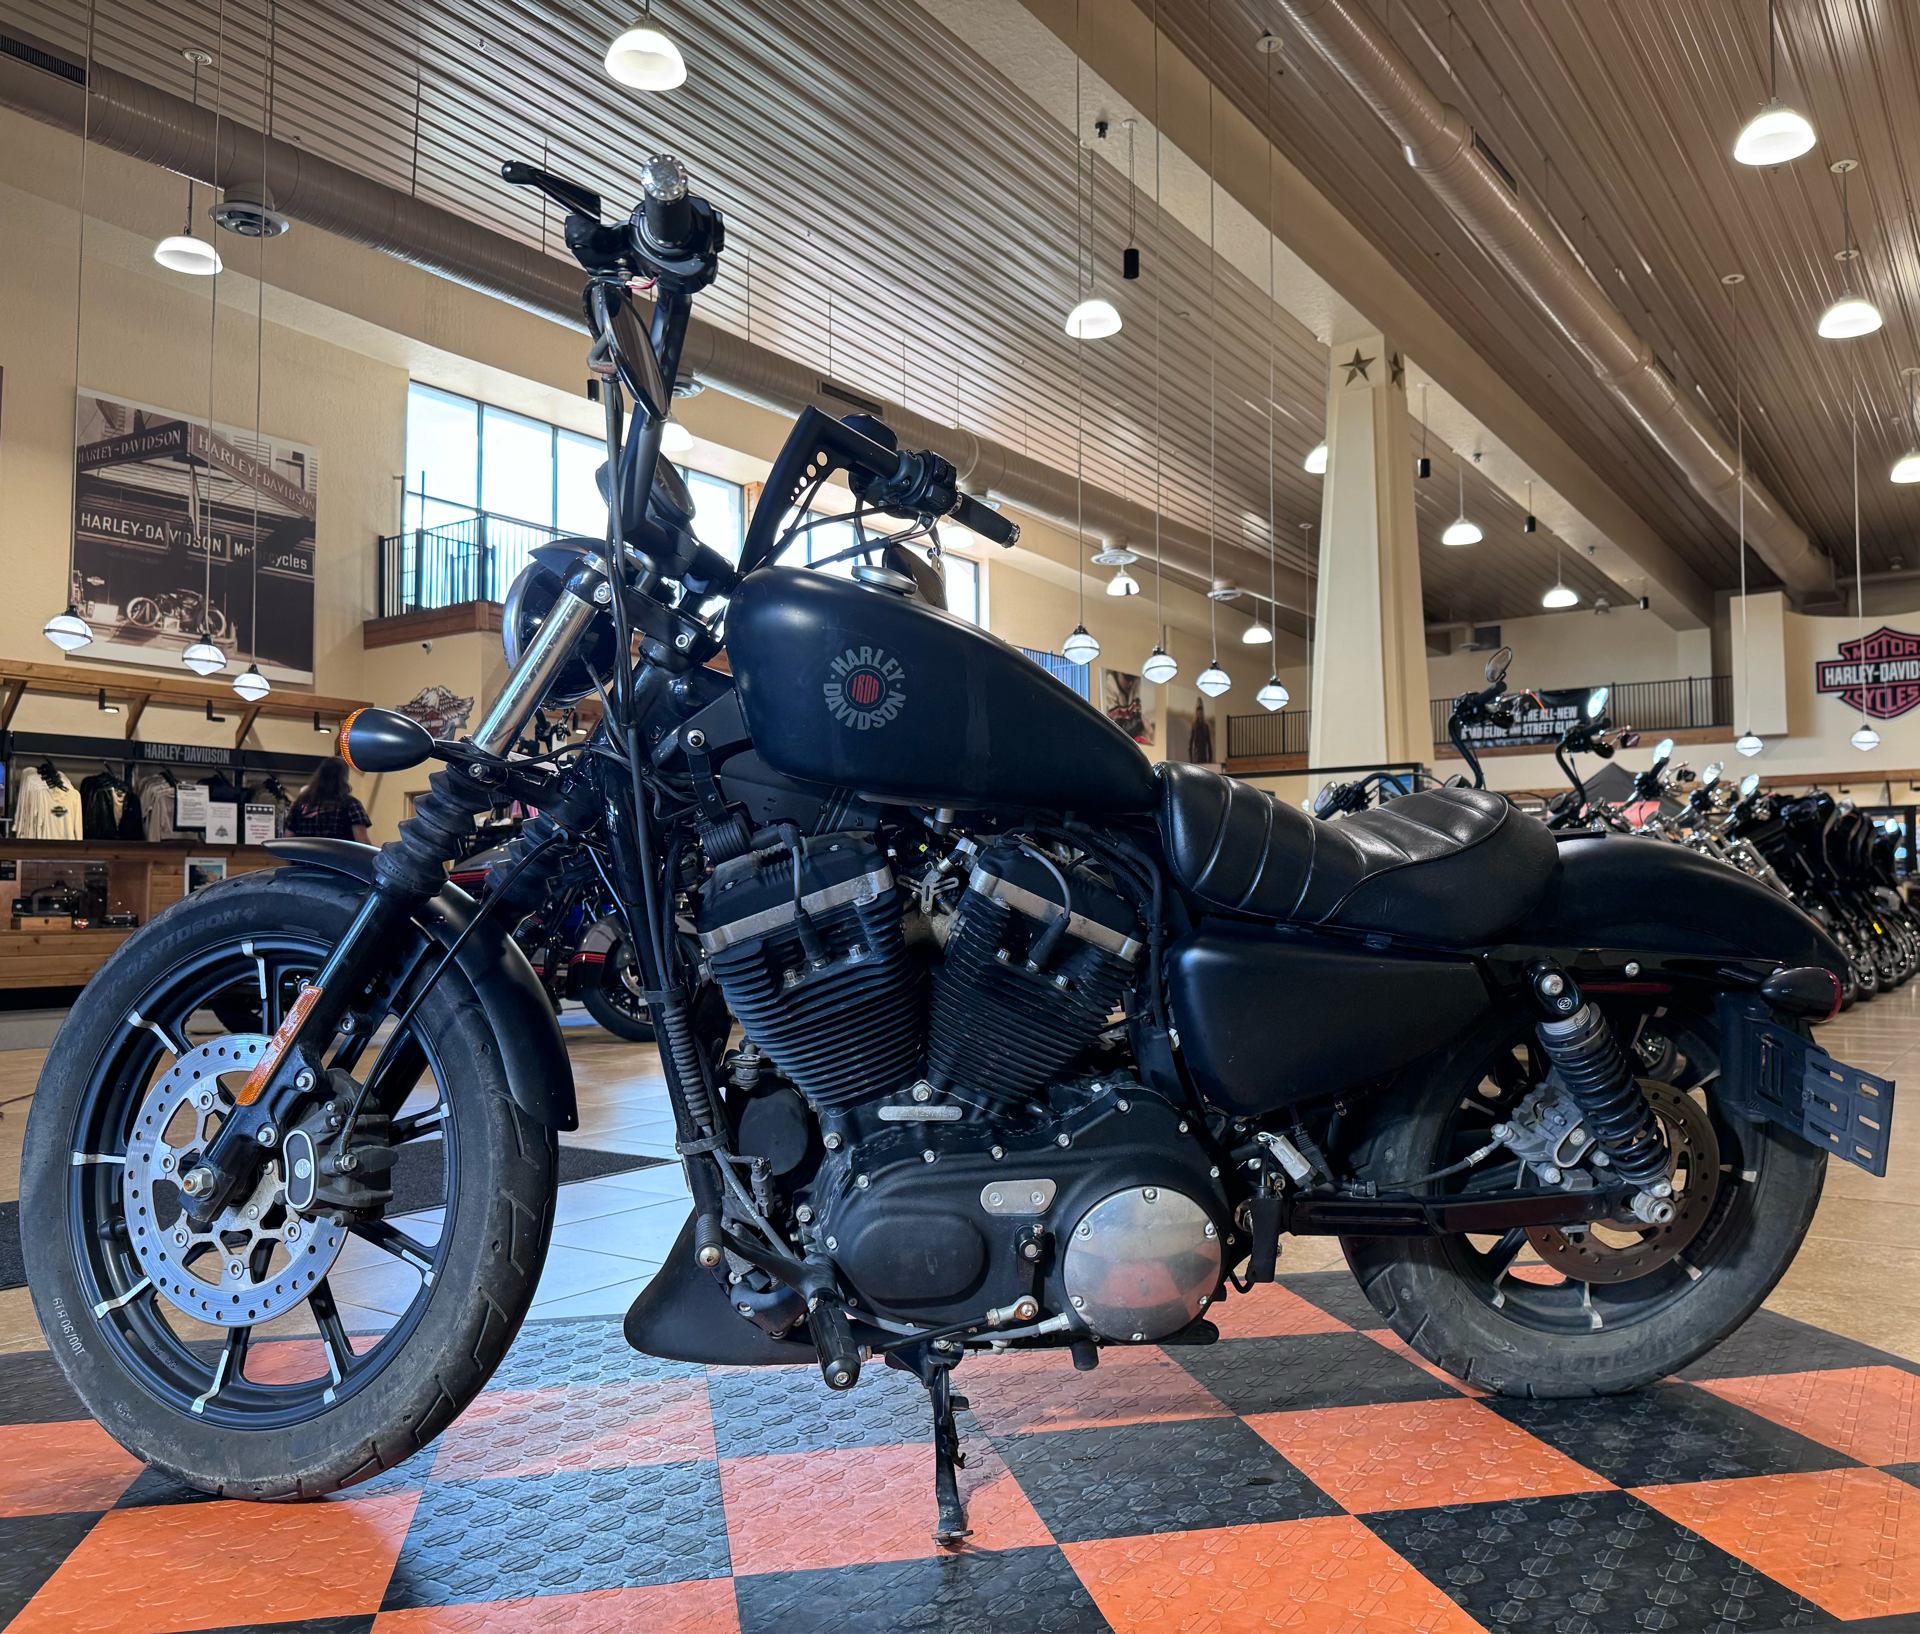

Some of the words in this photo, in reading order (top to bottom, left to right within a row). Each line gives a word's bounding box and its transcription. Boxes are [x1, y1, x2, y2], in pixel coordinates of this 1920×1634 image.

[78, 429, 181, 464] HARLEY-DAVIDSON
[198, 433, 315, 512] HARLEY-DAVIDSON
[81, 512, 222, 553] HARLEY-DAVIDSON
[1852, 635, 1918, 660] MOTOR
[830, 645, 906, 682] HARLEY
[1824, 660, 1920, 687] HARLEY-DAVID
[851, 674, 880, 705] IRON
[1853, 685, 1919, 712] CYCLES
[823, 682, 907, 731] DAVIDSON
[1540, 706, 1578, 720] ALL-NEW
[1522, 721, 1555, 736] STREET
[144, 743, 231, 765] HARLEY-DAVIDSON
[60, 1319, 86, 1357] 100/90
